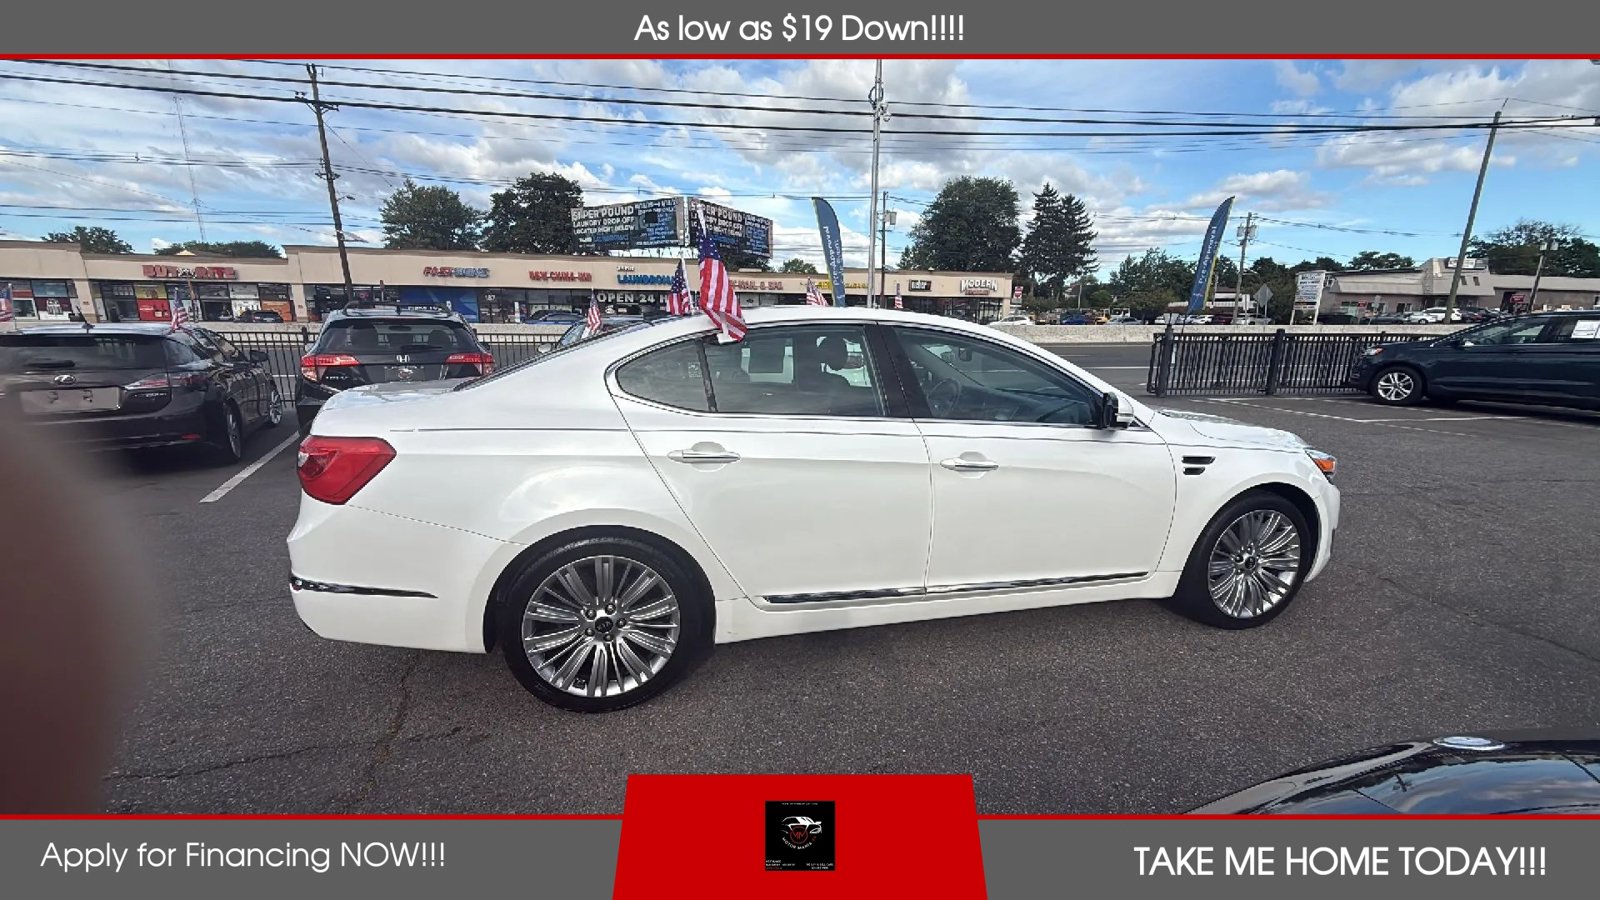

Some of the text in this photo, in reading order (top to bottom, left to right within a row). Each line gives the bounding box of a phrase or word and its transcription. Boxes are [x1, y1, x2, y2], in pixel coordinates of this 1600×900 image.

[601, 204, 635, 217] POUND
[717, 205, 743, 223] POUND
[961, 279, 998, 292] MODERN
[597, 292, 634, 303] OPEN
[639, 293, 656, 303] 24
